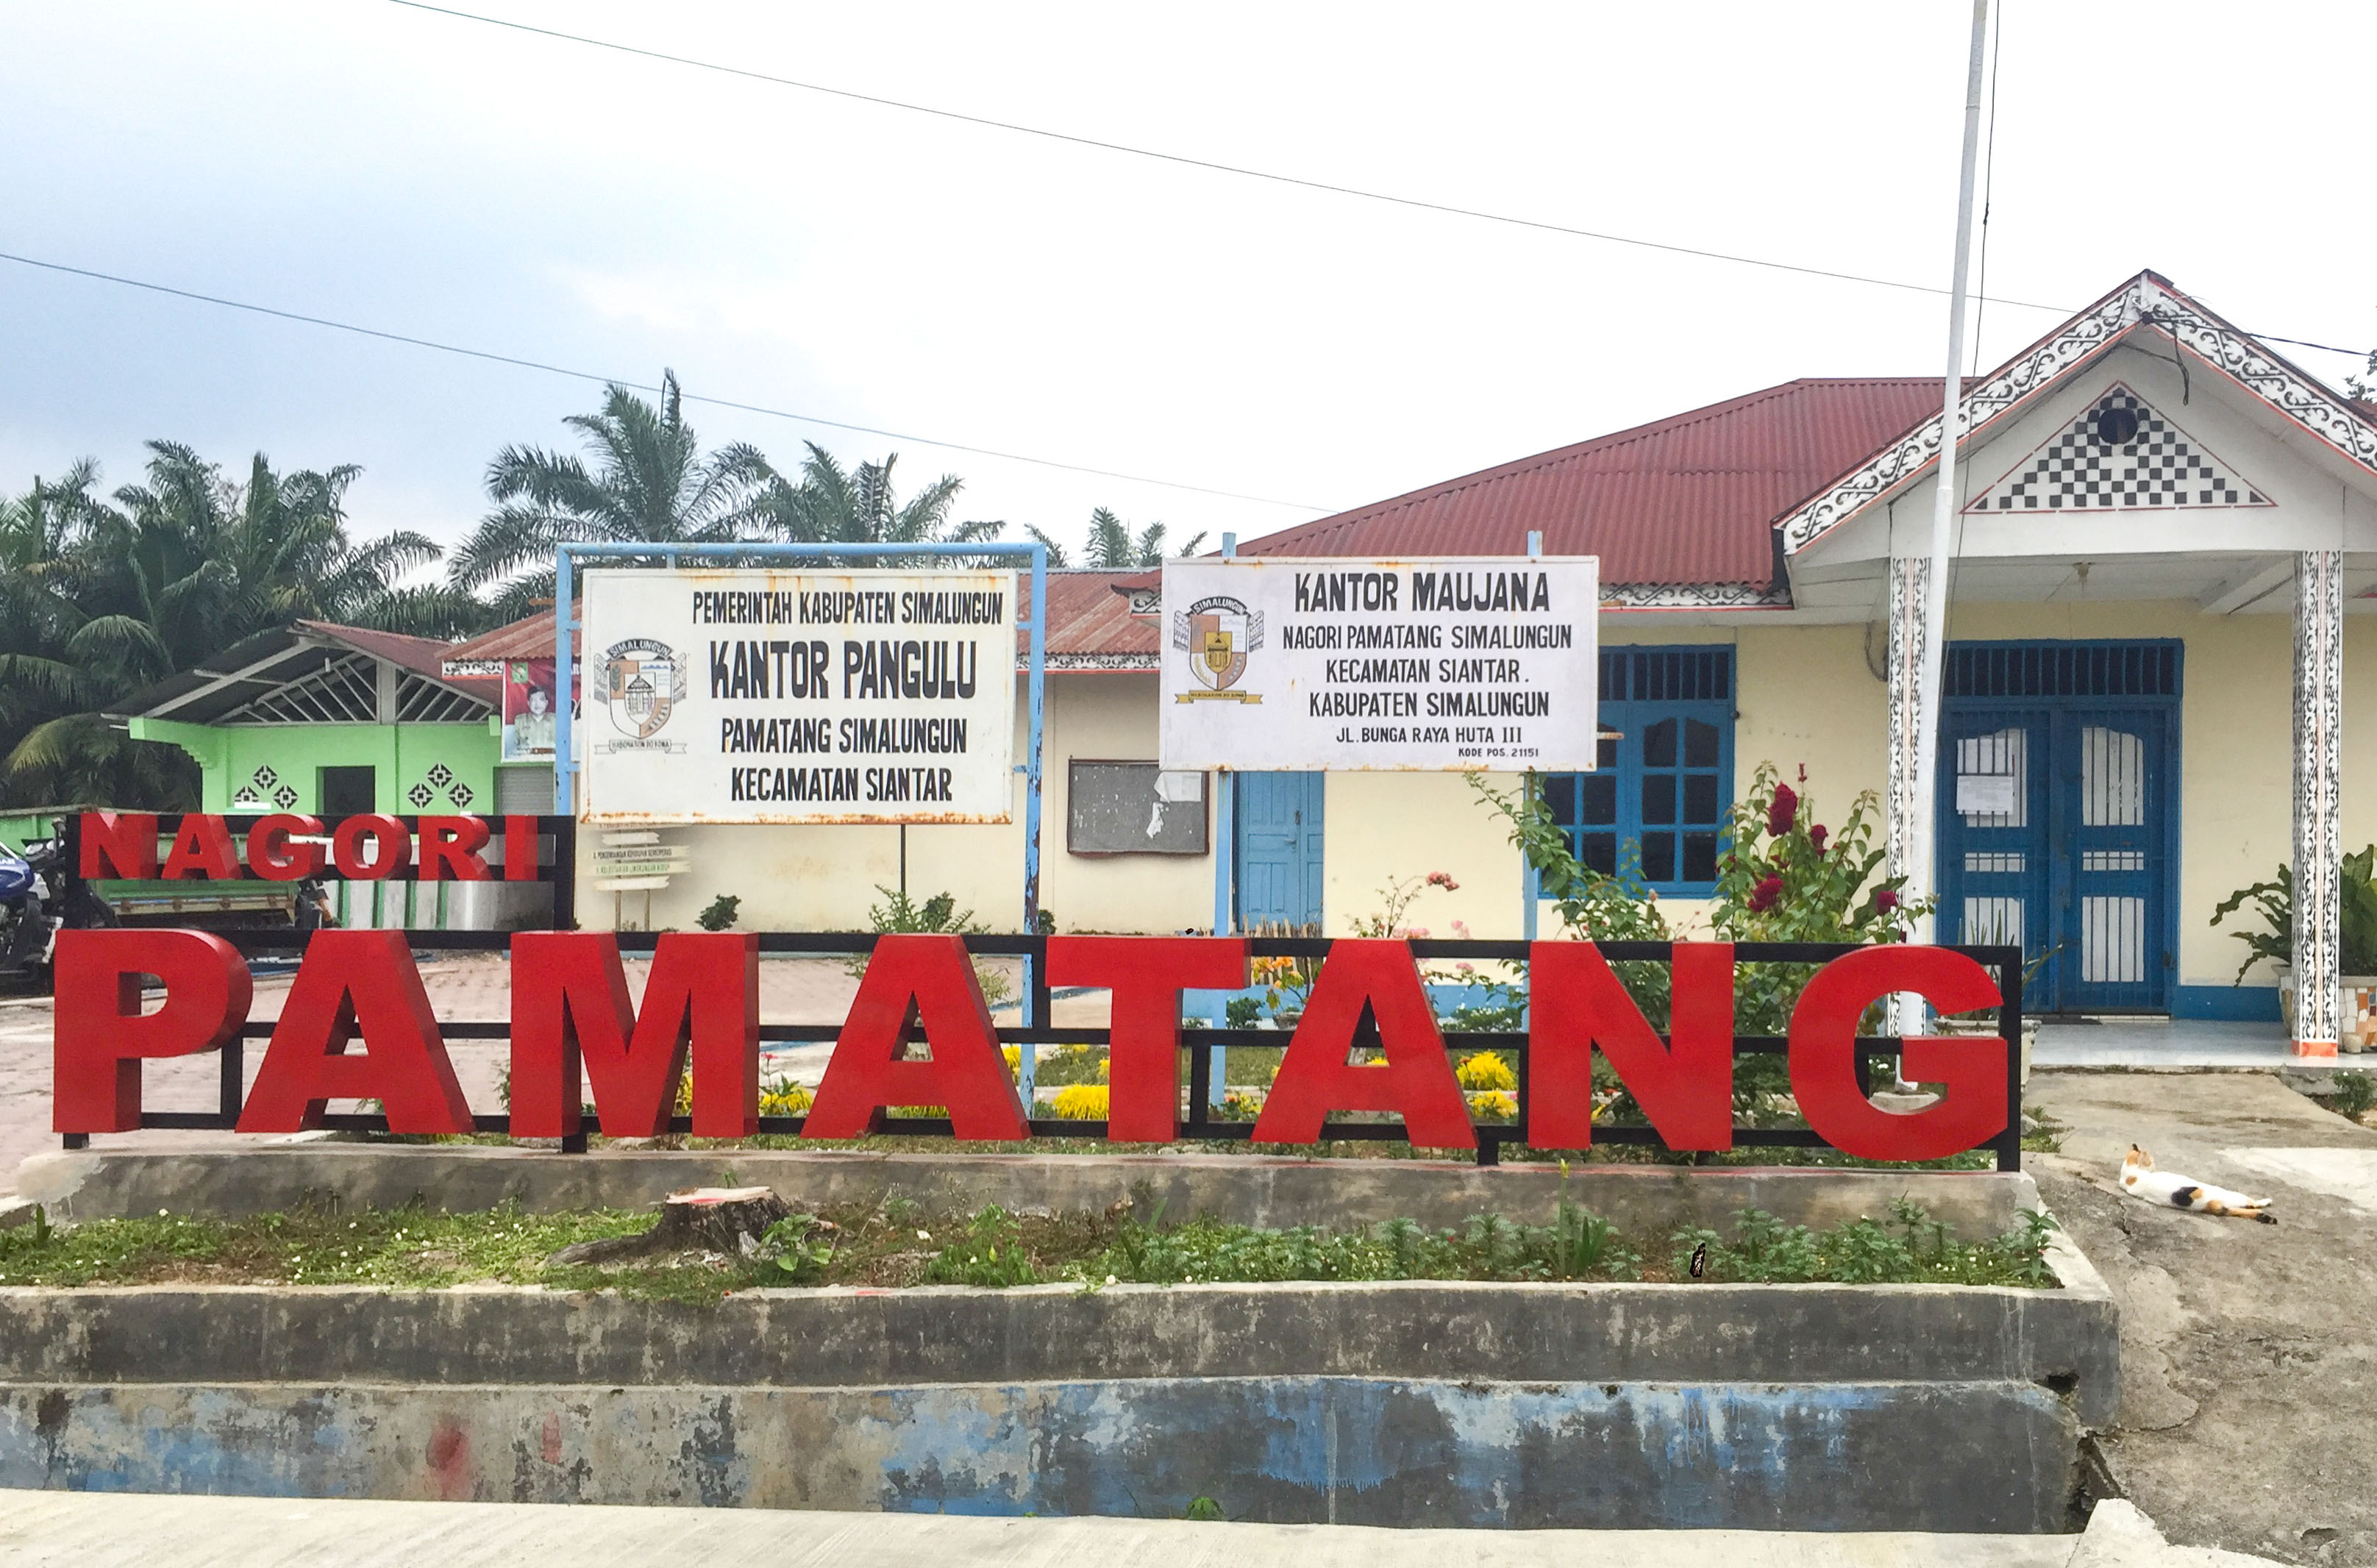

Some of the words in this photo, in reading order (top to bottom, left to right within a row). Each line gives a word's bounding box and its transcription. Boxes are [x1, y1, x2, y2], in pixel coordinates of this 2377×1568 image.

[1193, 598, 1246, 614] SIMALUNGUN
[1295, 573, 1398, 612] KANTOR
[1412, 572, 1550, 612] MAUJANA
[693, 591, 792, 624] PEMERINTAH
[799, 591, 895, 624] KABUPATEN
[902, 592, 1003, 624] SIMALUNGUN
[609, 640, 670, 657] SIMALUNGUN
[1283, 626, 1341, 649] NAGORI
[1347, 625, 1441, 649] PAMATANG
[1451, 624, 1572, 649] SIMALUNGUN
[710, 641, 829, 699] KANTOR
[844, 641, 976, 699] PANGULU
[1326, 659, 1430, 683] KECAMATAN
[1310, 692, 1417, 717] KABUPATEN
[1426, 691, 1549, 717] SIMALUNGUN
[721, 718, 831, 754] PAMATANG
[839, 718, 967, 754] SIMALUNGUN
[1412, 727, 1450, 743] RAYA
[1455, 727, 1494, 743] HUTA
[1503, 727, 1522, 743] III
[1458, 748, 1482, 757] KODE
[1511, 748, 1539, 758] 21151
[732, 767, 858, 802] KECAMATAN
[866, 768, 952, 802] SIANTAR
[79, 812, 538, 881] NAGORI
[54, 928, 2009, 1162] PAMATANG
